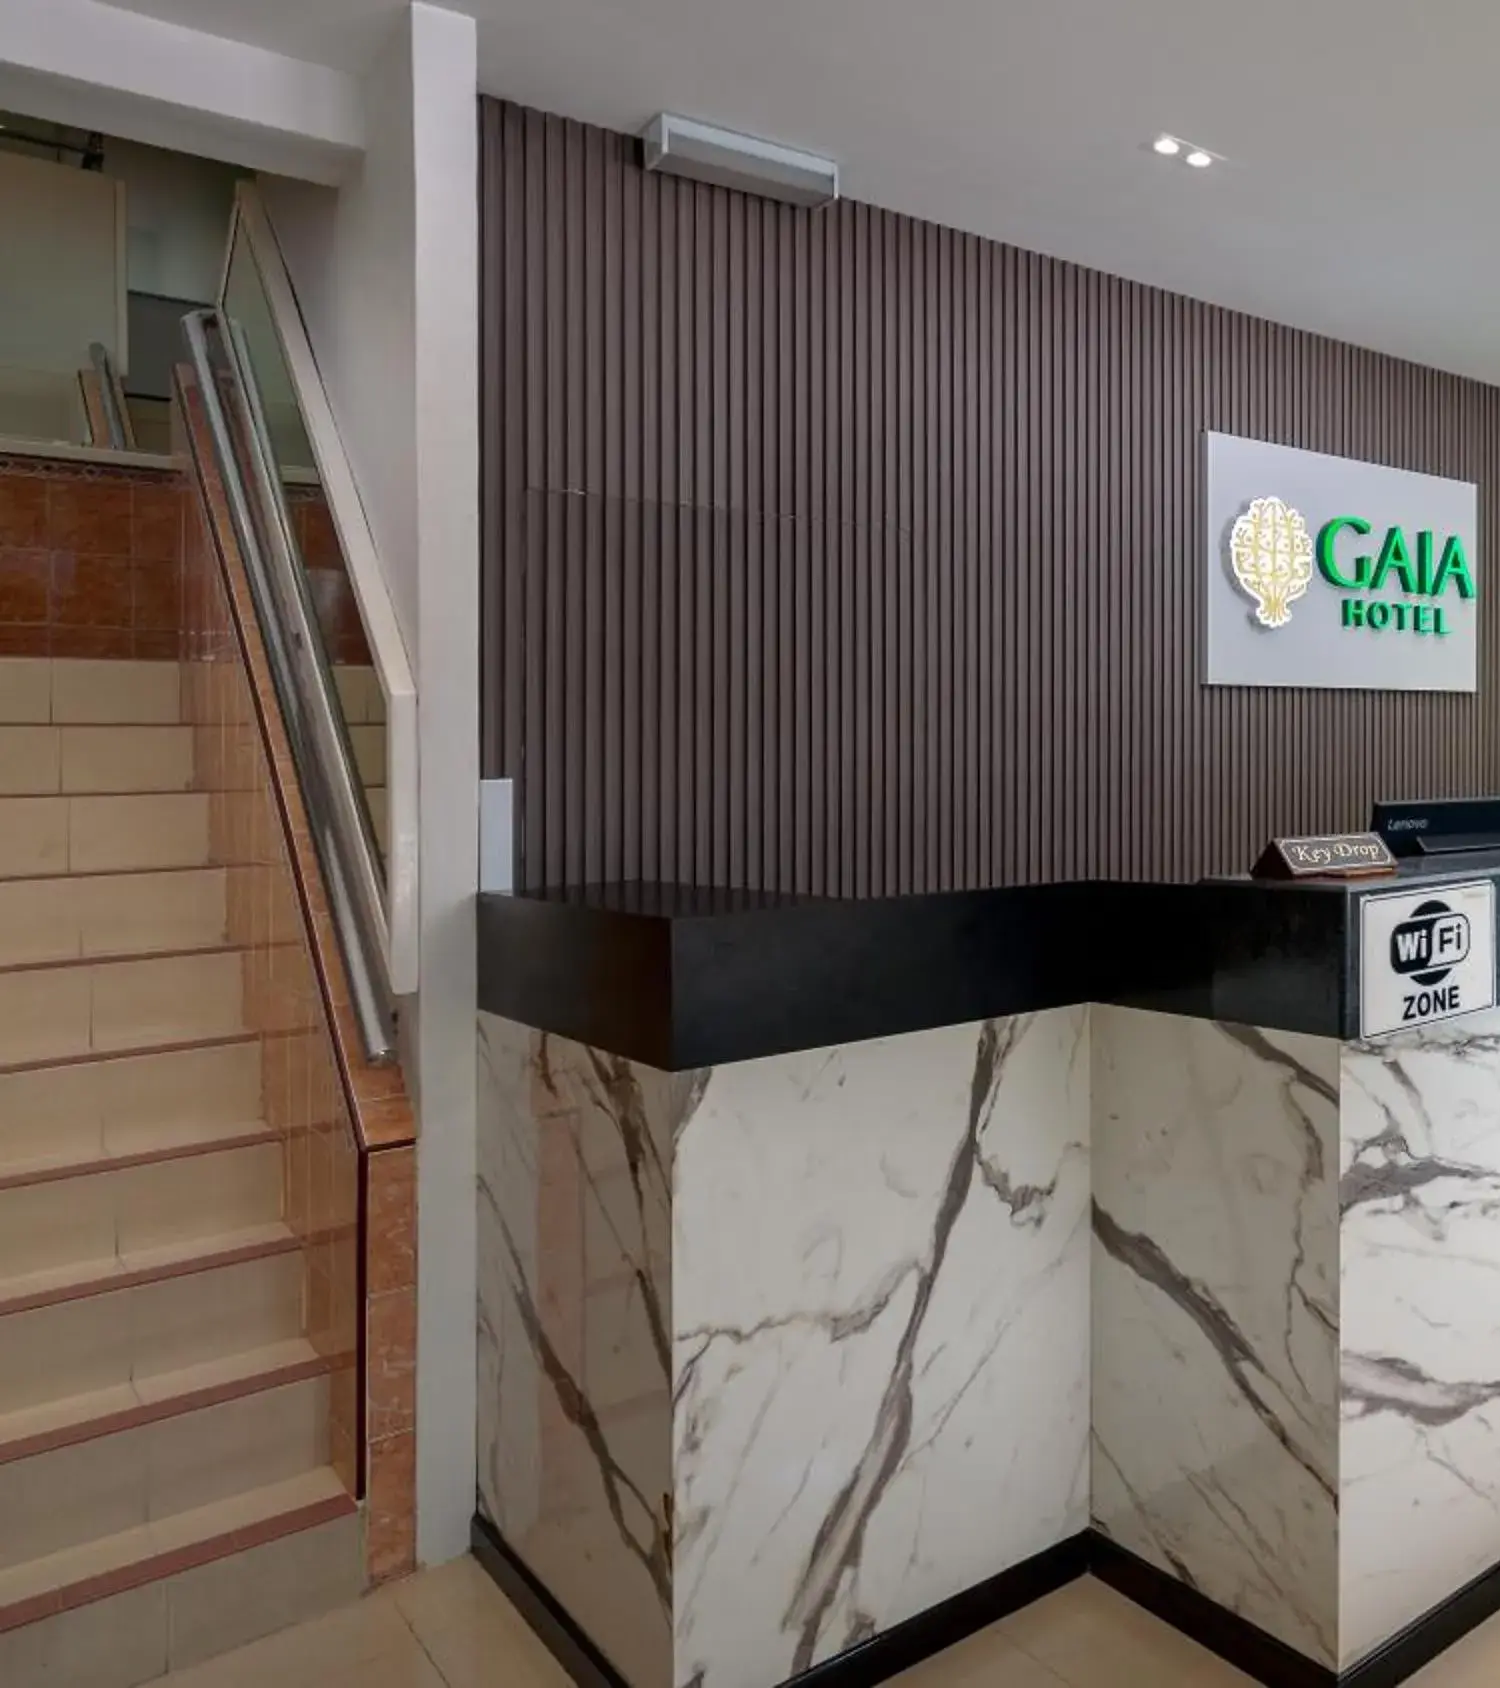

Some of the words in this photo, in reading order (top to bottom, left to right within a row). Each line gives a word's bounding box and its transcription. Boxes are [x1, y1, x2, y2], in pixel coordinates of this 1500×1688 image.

[1316, 515, 1475, 599] GAIA
[1341, 599, 1452, 635] HOTEL
[1291, 844, 1331, 865] Key
[1333, 843, 1379, 861] Drop
[1402, 985, 1460, 1021] ZONE
